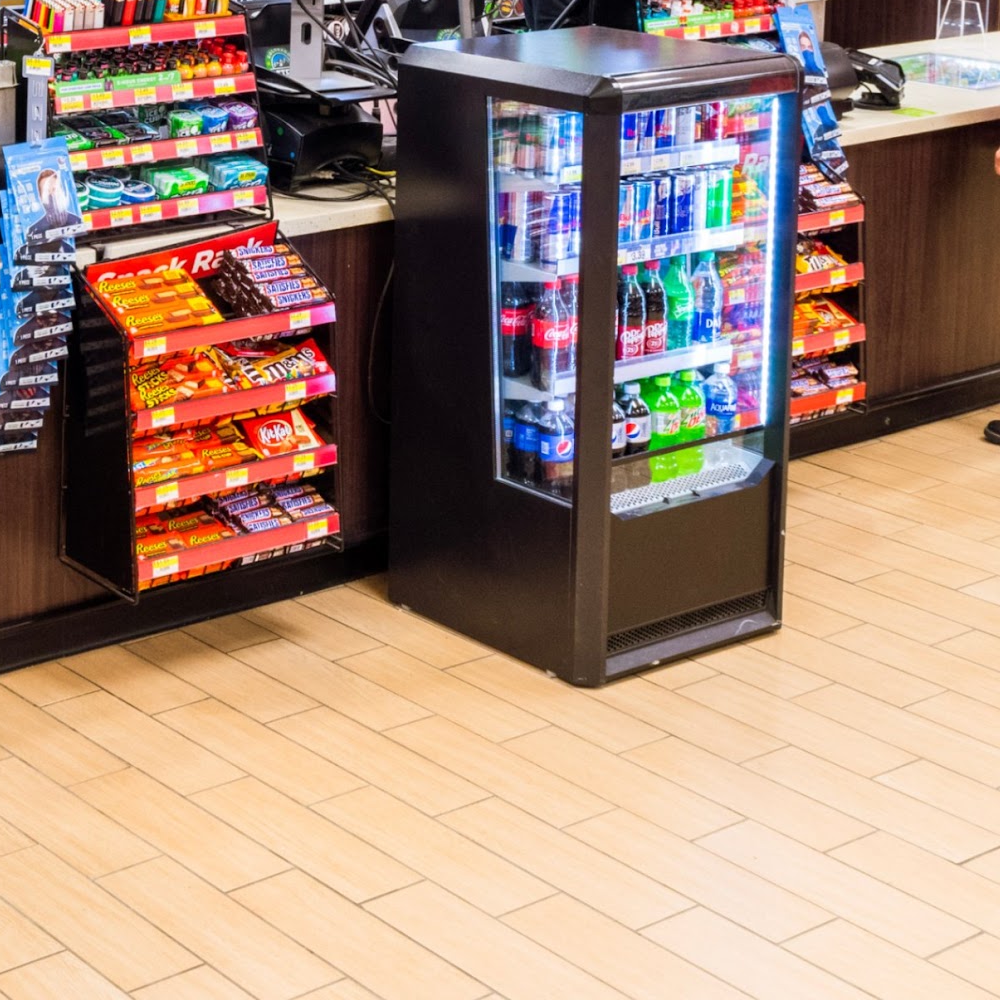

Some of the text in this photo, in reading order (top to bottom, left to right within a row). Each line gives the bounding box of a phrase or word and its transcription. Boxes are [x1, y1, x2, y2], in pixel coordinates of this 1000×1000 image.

[191, 236, 263, 274] Rak
[238, 246, 273, 256] SNICKERS
[255, 269, 289, 280] SATISFIES
[266, 281, 300, 294] SATISFIES
[277, 291, 311, 304] SNICKERS
